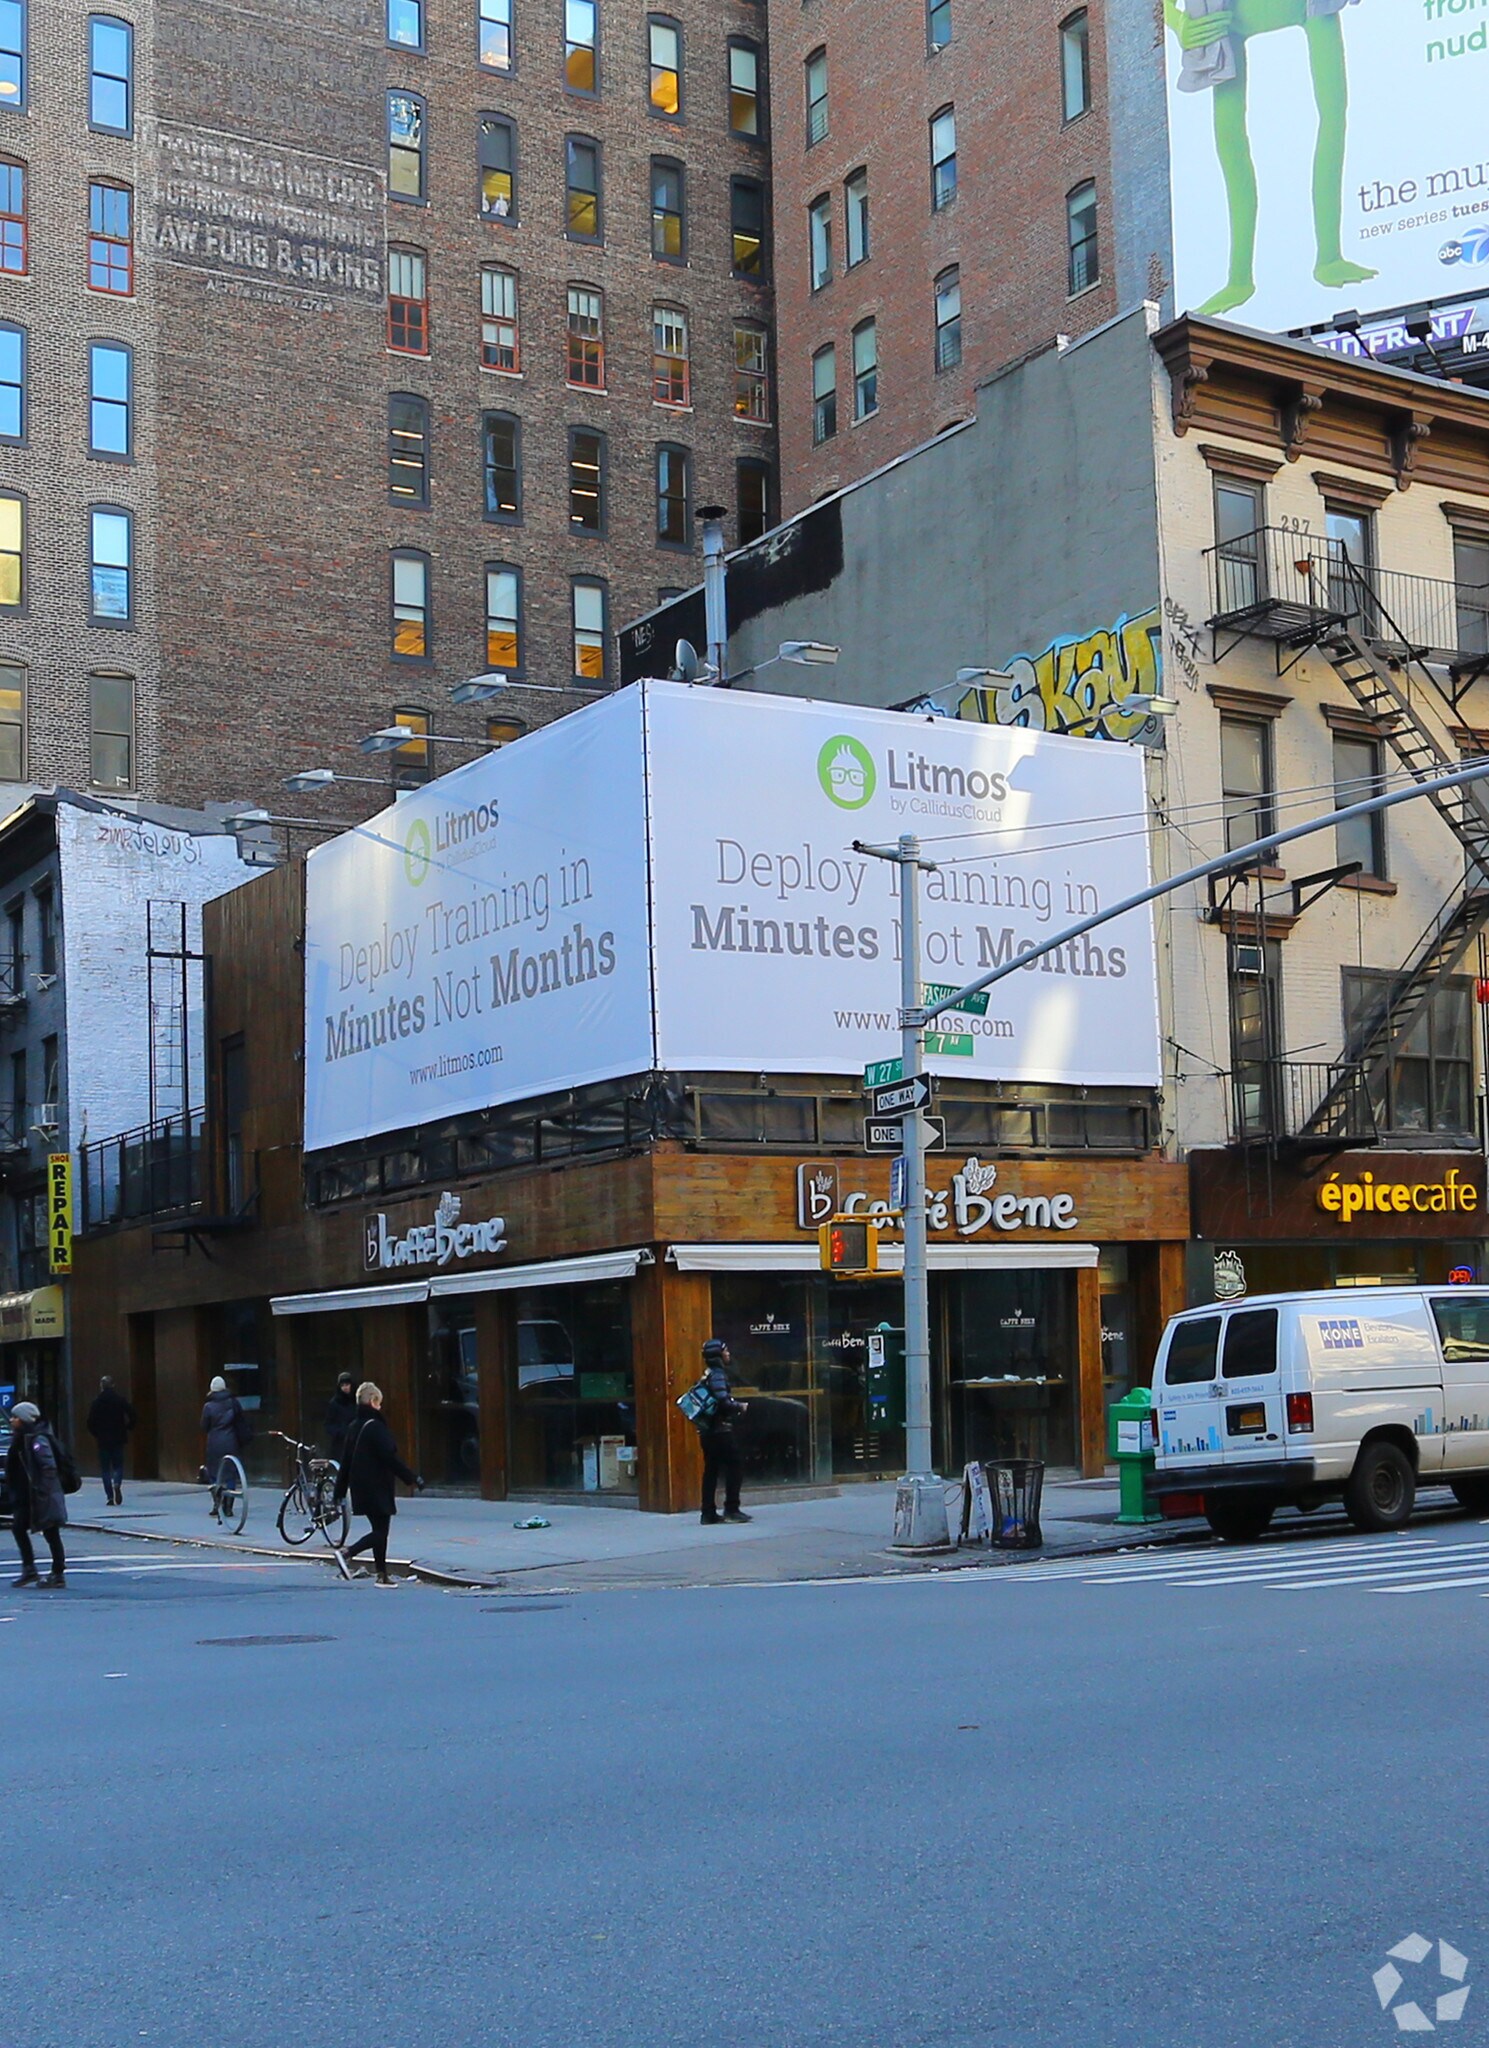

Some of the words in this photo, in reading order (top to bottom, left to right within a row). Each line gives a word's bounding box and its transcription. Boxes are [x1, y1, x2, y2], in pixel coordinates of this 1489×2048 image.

[1358, 180, 1417, 213] the
[1426, 162, 1489, 198] mu
[1359, 222, 1392, 239] new
[1397, 209, 1448, 231] series
[1439, 246, 1463, 260] abc
[1281, 515, 1310, 535] 297
[887, 749, 1007, 801] Litmos
[890, 796, 907, 815] by
[910, 797, 1003, 822] CallidusCloud
[436, 799, 499, 852] Litmos
[715, 839, 868, 906] Deploy
[1064, 871, 1099, 915] in
[339, 923, 419, 993] Deploy
[426, 870, 549, 955] Training
[560, 848, 593, 908] in
[690, 905, 879, 960] Minutes
[325, 995, 426, 1062] Minutes
[433, 965, 482, 1027] Not
[490, 922, 616, 1009] Months
[971, 993, 987, 1005] AVE
[936, 1034, 945, 1053] 7
[409, 1043, 503, 1085] www.litmos.com
[867, 1067, 876, 1084] W
[879, 1063, 892, 1083] 27
[879, 1092, 895, 1109] ONE
[899, 1086, 916, 1103] WAY
[873, 1128, 896, 1142] ONE
[52, 1164, 69, 1263] REPAIR
[953, 1172, 1079, 1236] bene
[1448, 1270, 1471, 1283] OPEN
[1321, 1328, 1361, 1341] KONE
